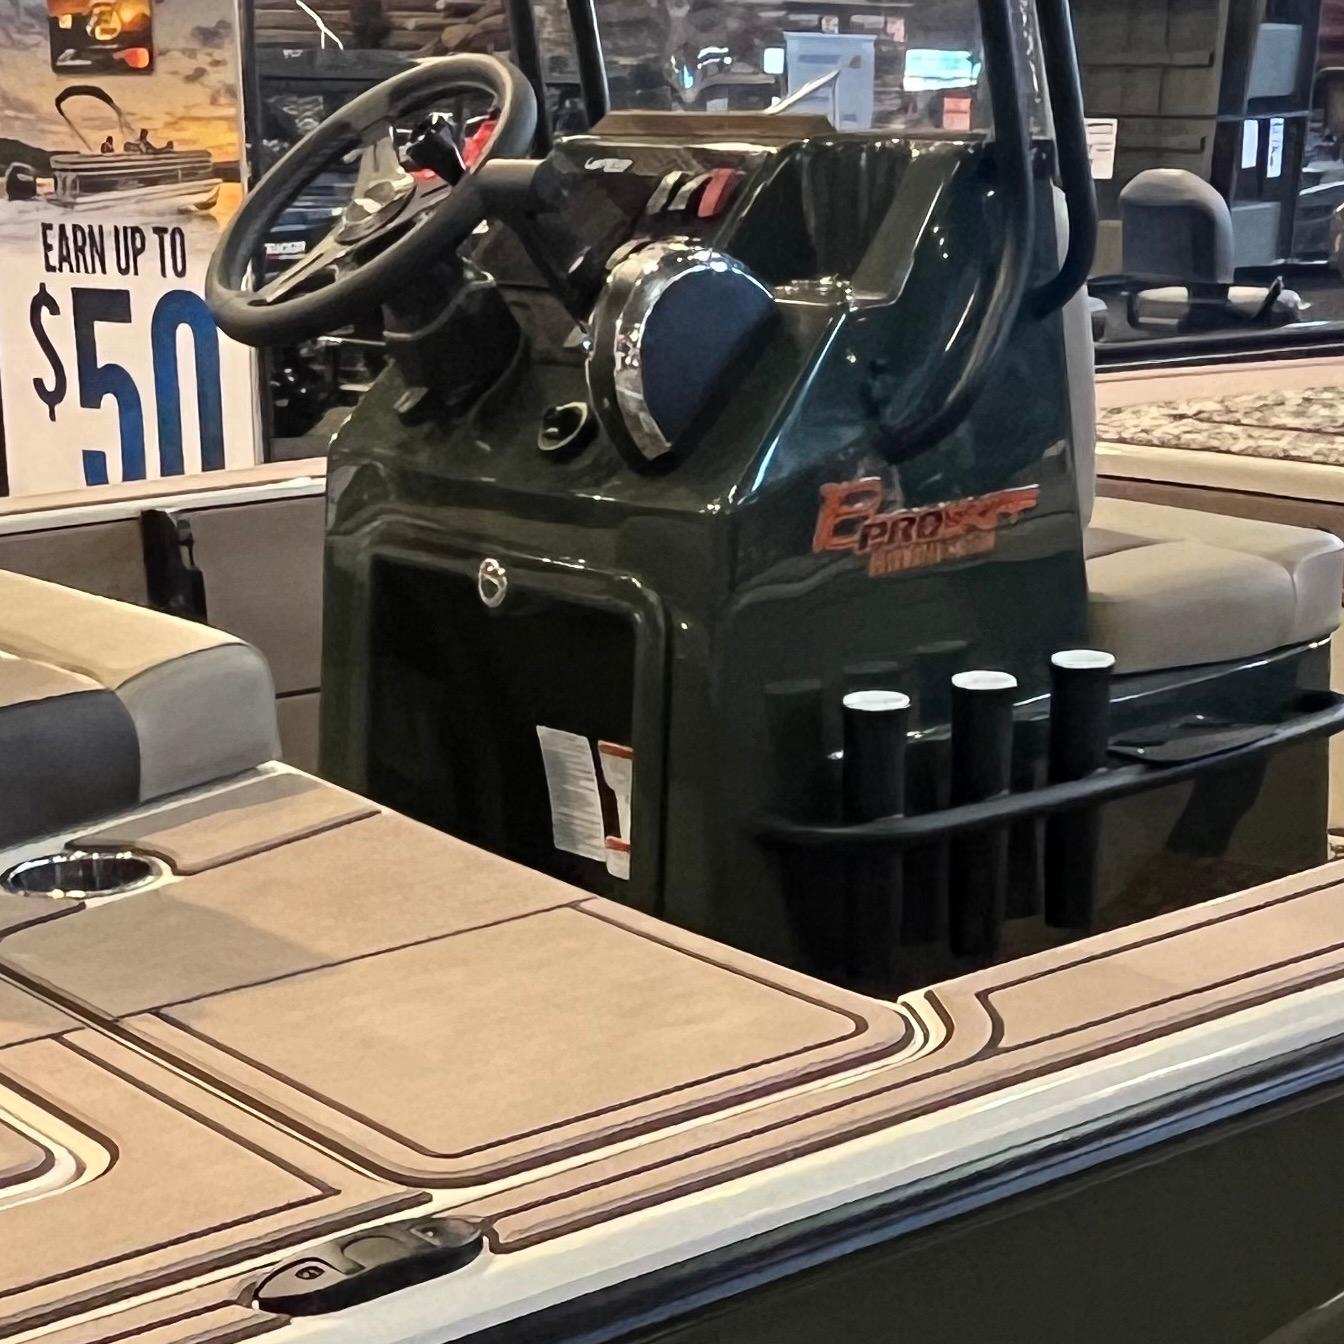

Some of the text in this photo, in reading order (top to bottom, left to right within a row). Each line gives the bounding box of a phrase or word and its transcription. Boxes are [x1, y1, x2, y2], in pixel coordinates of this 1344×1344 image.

[40, 222, 187, 278] EARN UP TO
